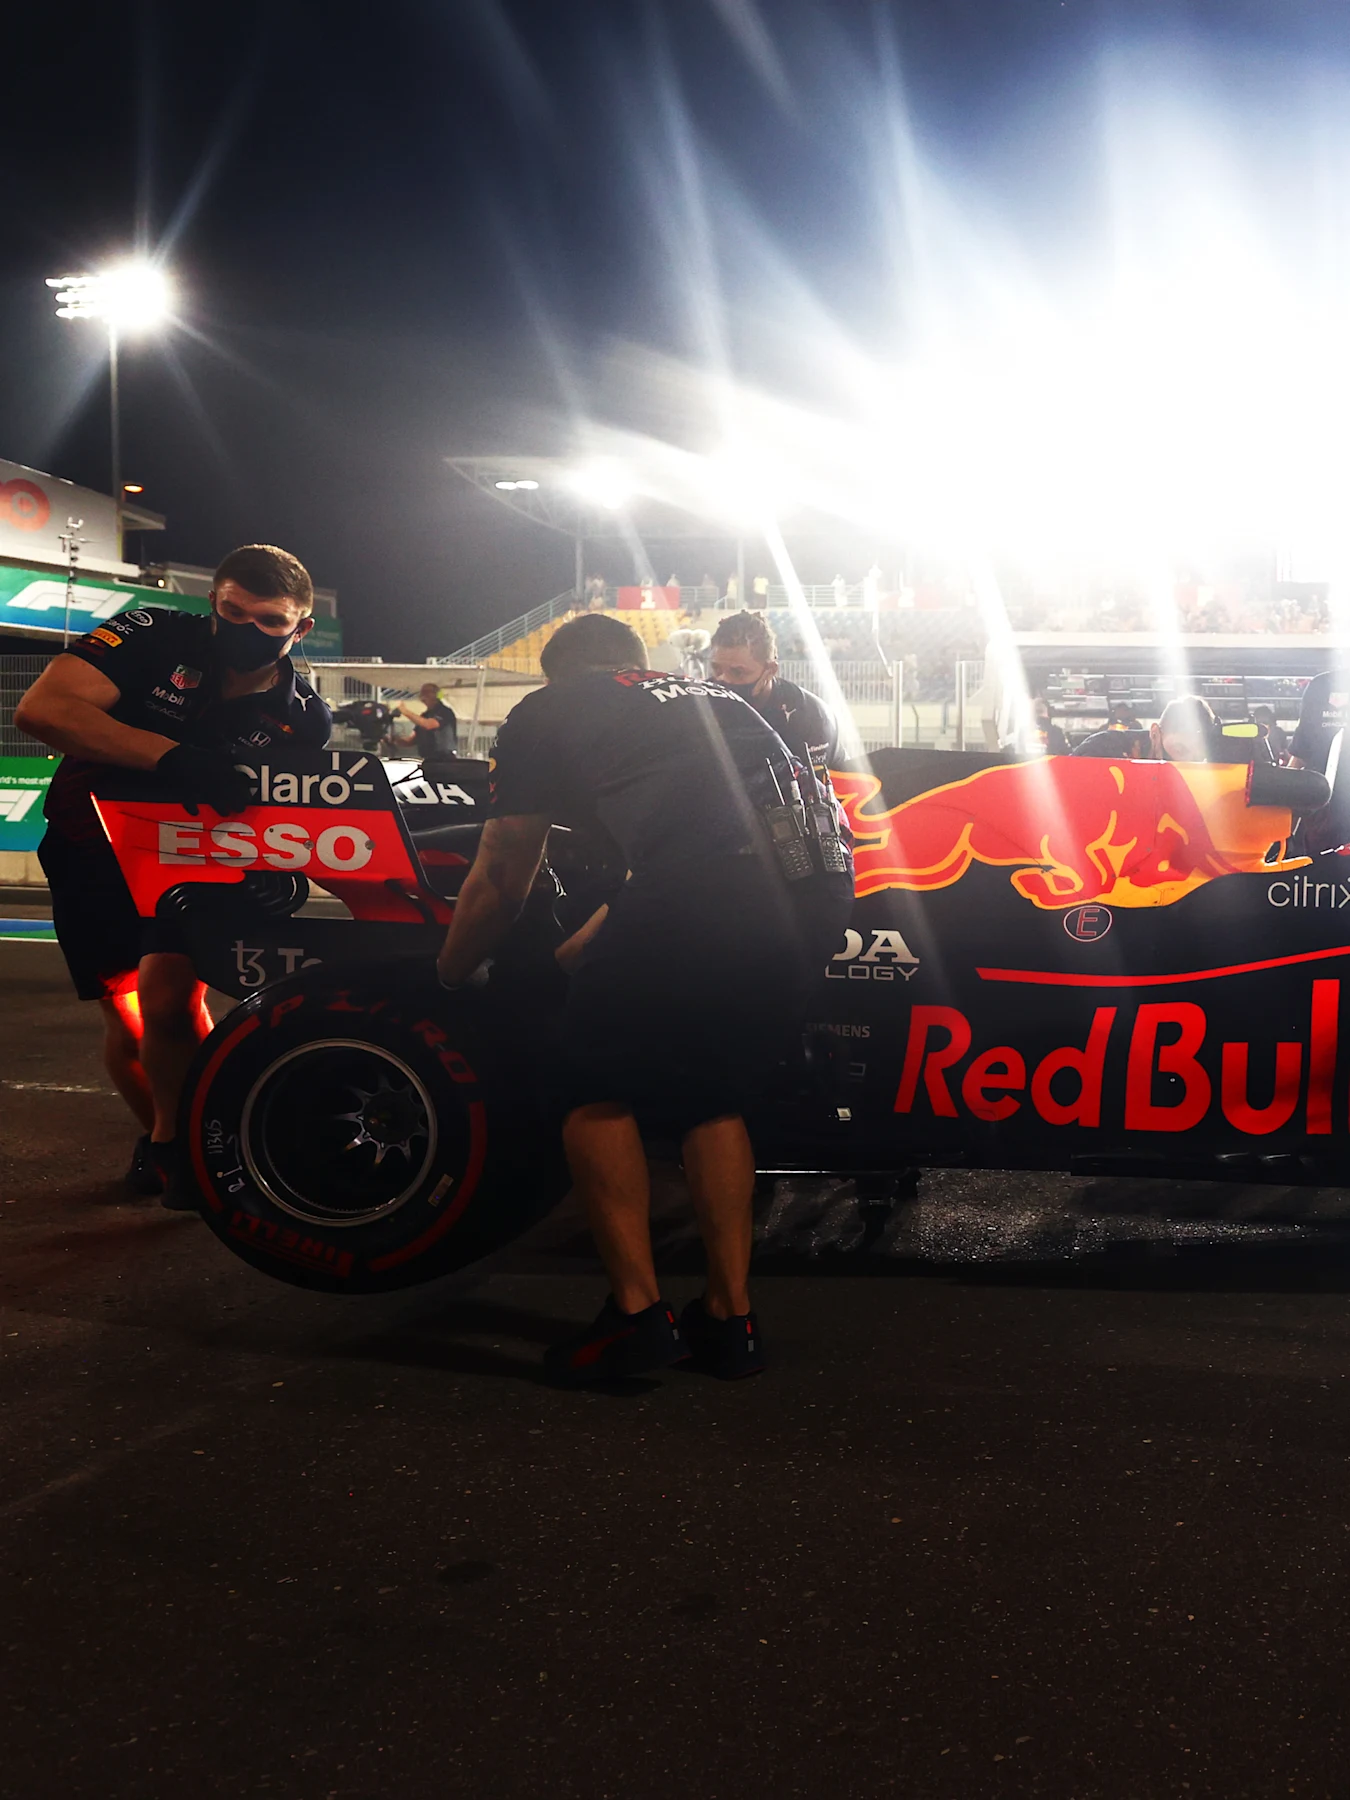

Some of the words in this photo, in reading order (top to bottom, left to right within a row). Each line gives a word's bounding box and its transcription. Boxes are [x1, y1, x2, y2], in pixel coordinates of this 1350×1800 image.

[151, 685, 186, 706] Mobil
[651, 684, 743, 703] Mobil
[158, 821, 373, 872] ESSO
[893, 1004, 1118, 1131] Red
